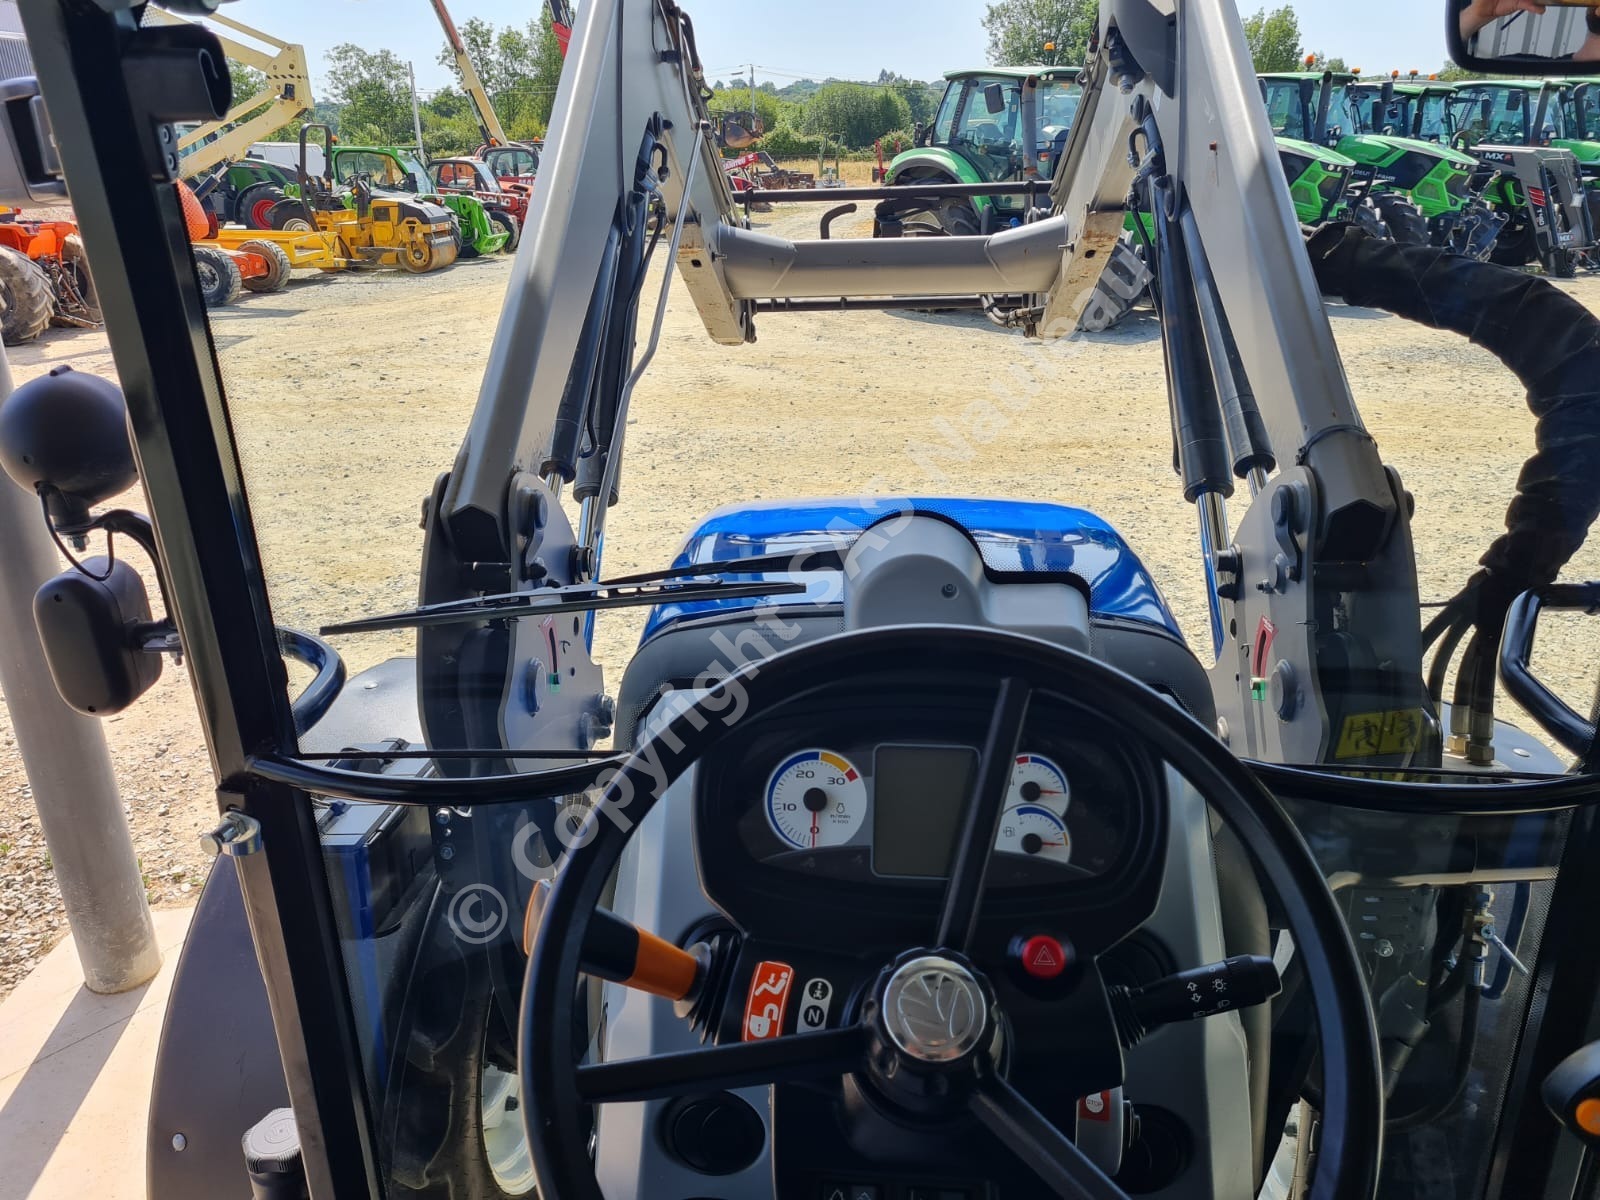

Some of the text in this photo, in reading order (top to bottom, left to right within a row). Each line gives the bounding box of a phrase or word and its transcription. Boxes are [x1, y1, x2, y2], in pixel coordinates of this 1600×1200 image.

[796, 770, 814, 778] 20
[827, 777, 846, 785] 30
[782, 803, 796, 811] 10
[807, 1009, 821, 1024] N
